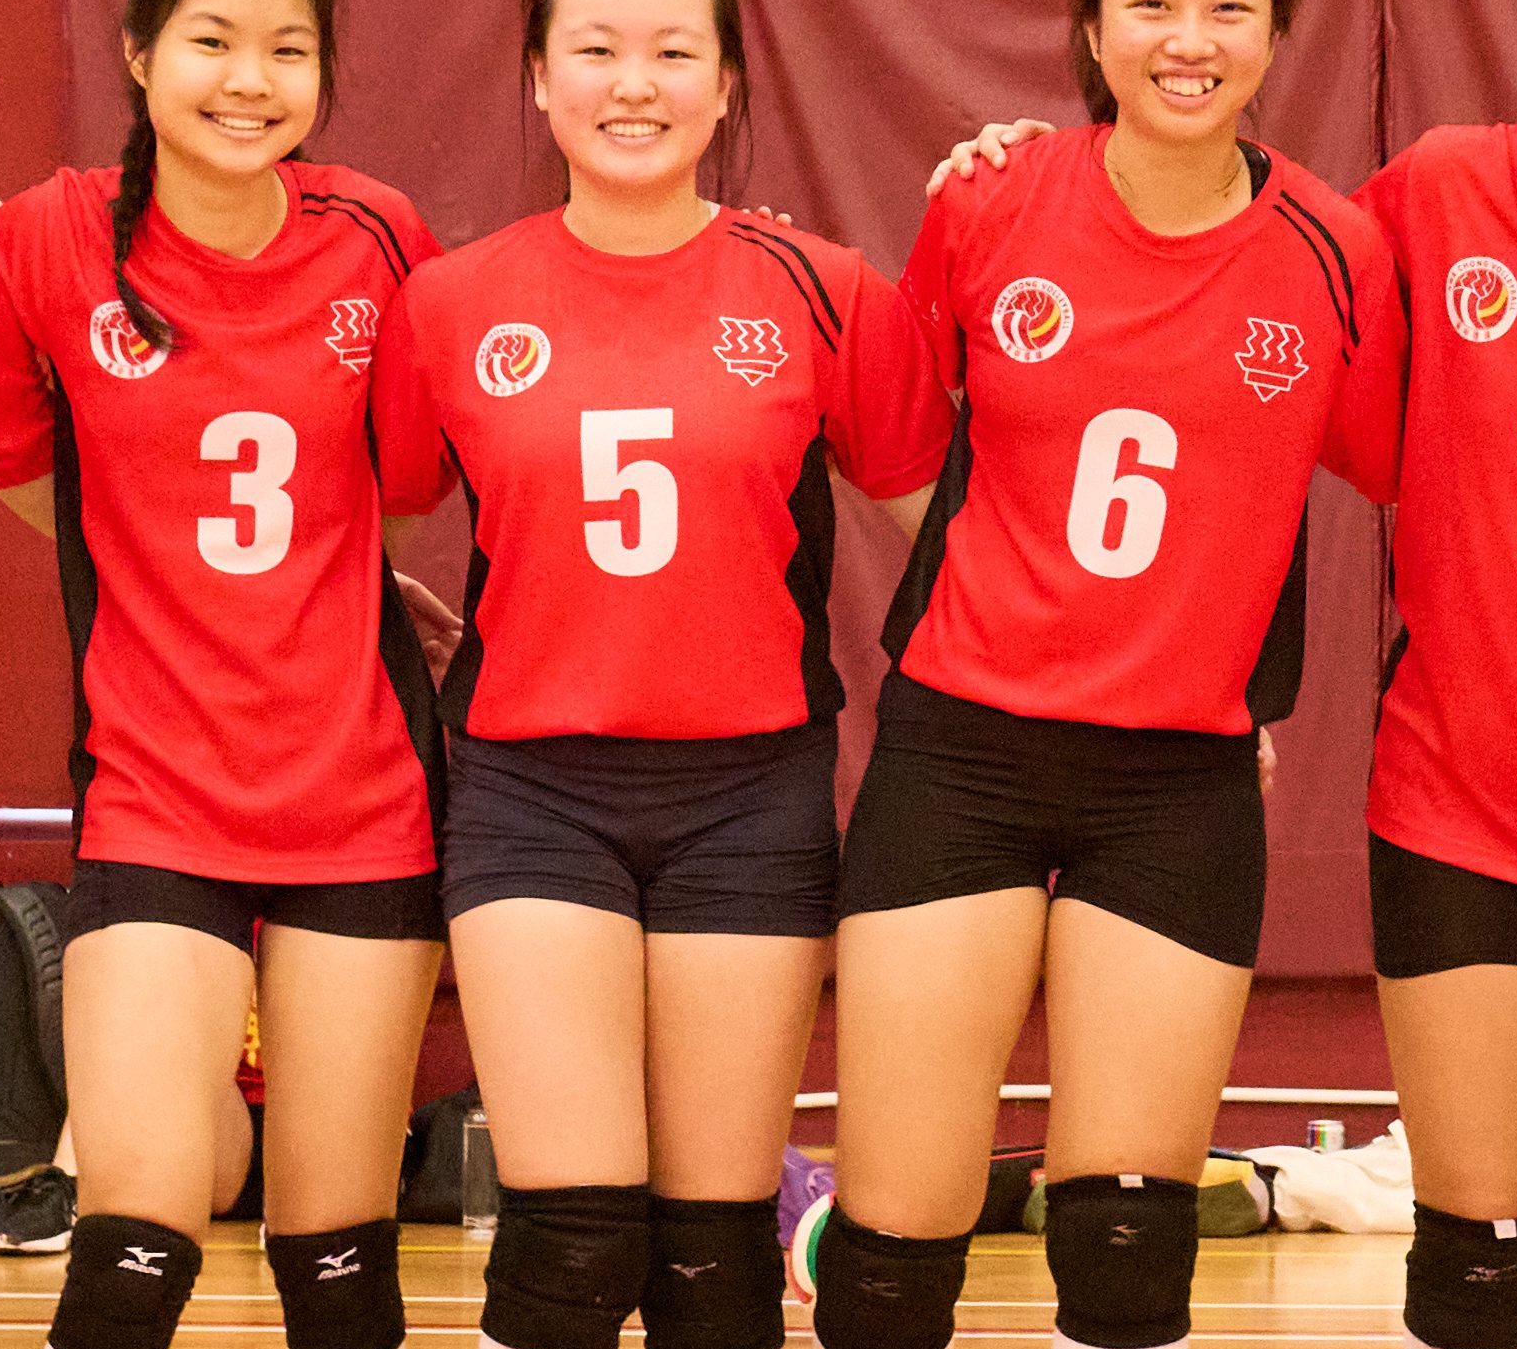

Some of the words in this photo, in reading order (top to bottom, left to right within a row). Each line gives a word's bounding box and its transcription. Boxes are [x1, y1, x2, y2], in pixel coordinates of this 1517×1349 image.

[197, 412, 296, 574] 3
[581, 408, 678, 576] 5
[1067, 408, 1177, 578] 6
